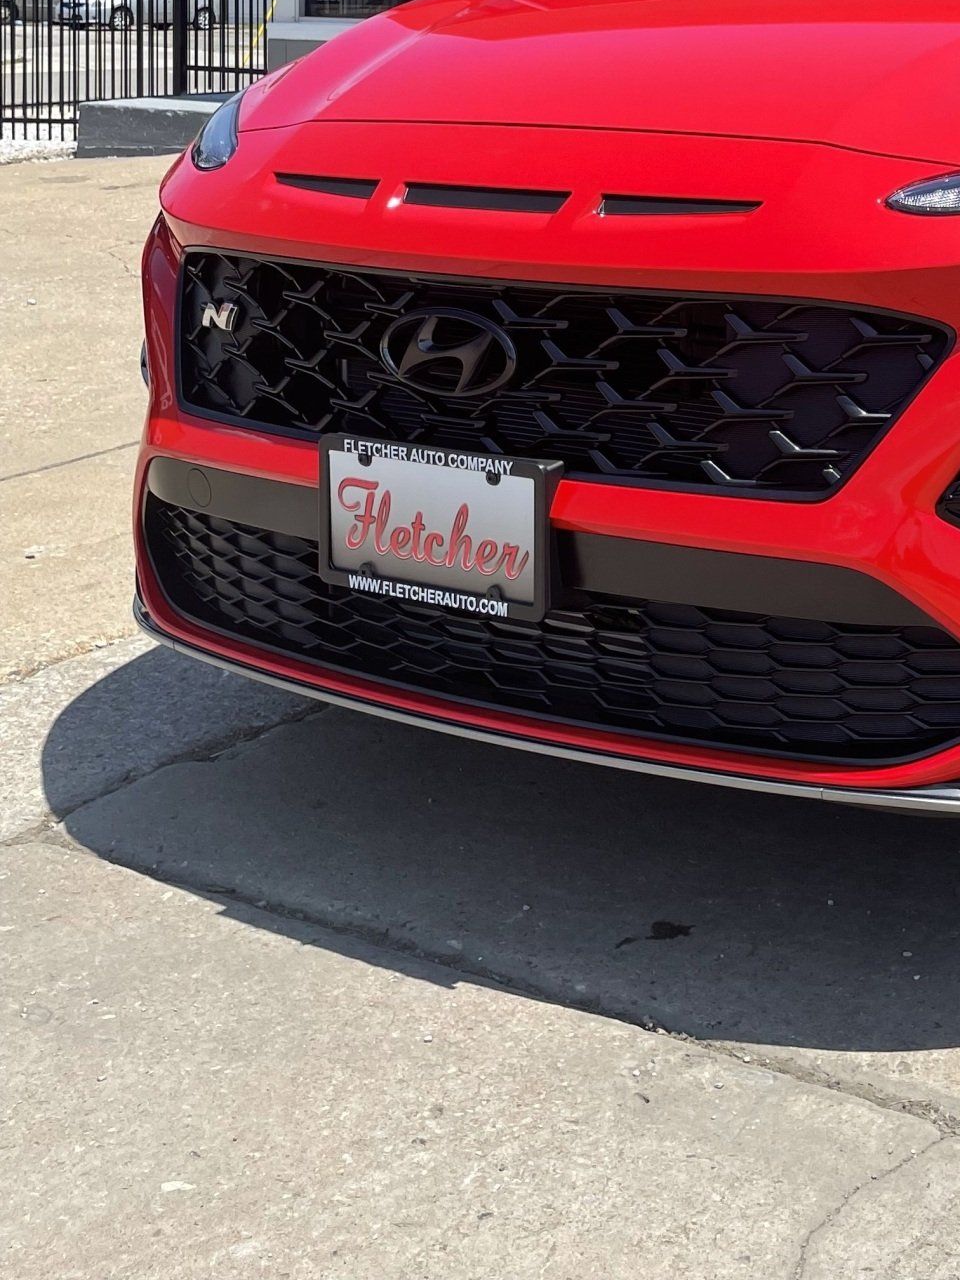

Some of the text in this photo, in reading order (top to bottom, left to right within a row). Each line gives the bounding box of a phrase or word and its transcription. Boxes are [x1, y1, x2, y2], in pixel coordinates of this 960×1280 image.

[344, 438, 514, 476] FLETCHER AUTO COMPANY
[337, 476, 530, 581] Fletcher
[348, 574, 509, 618] WWW.FLETCHERAUTO.COM
